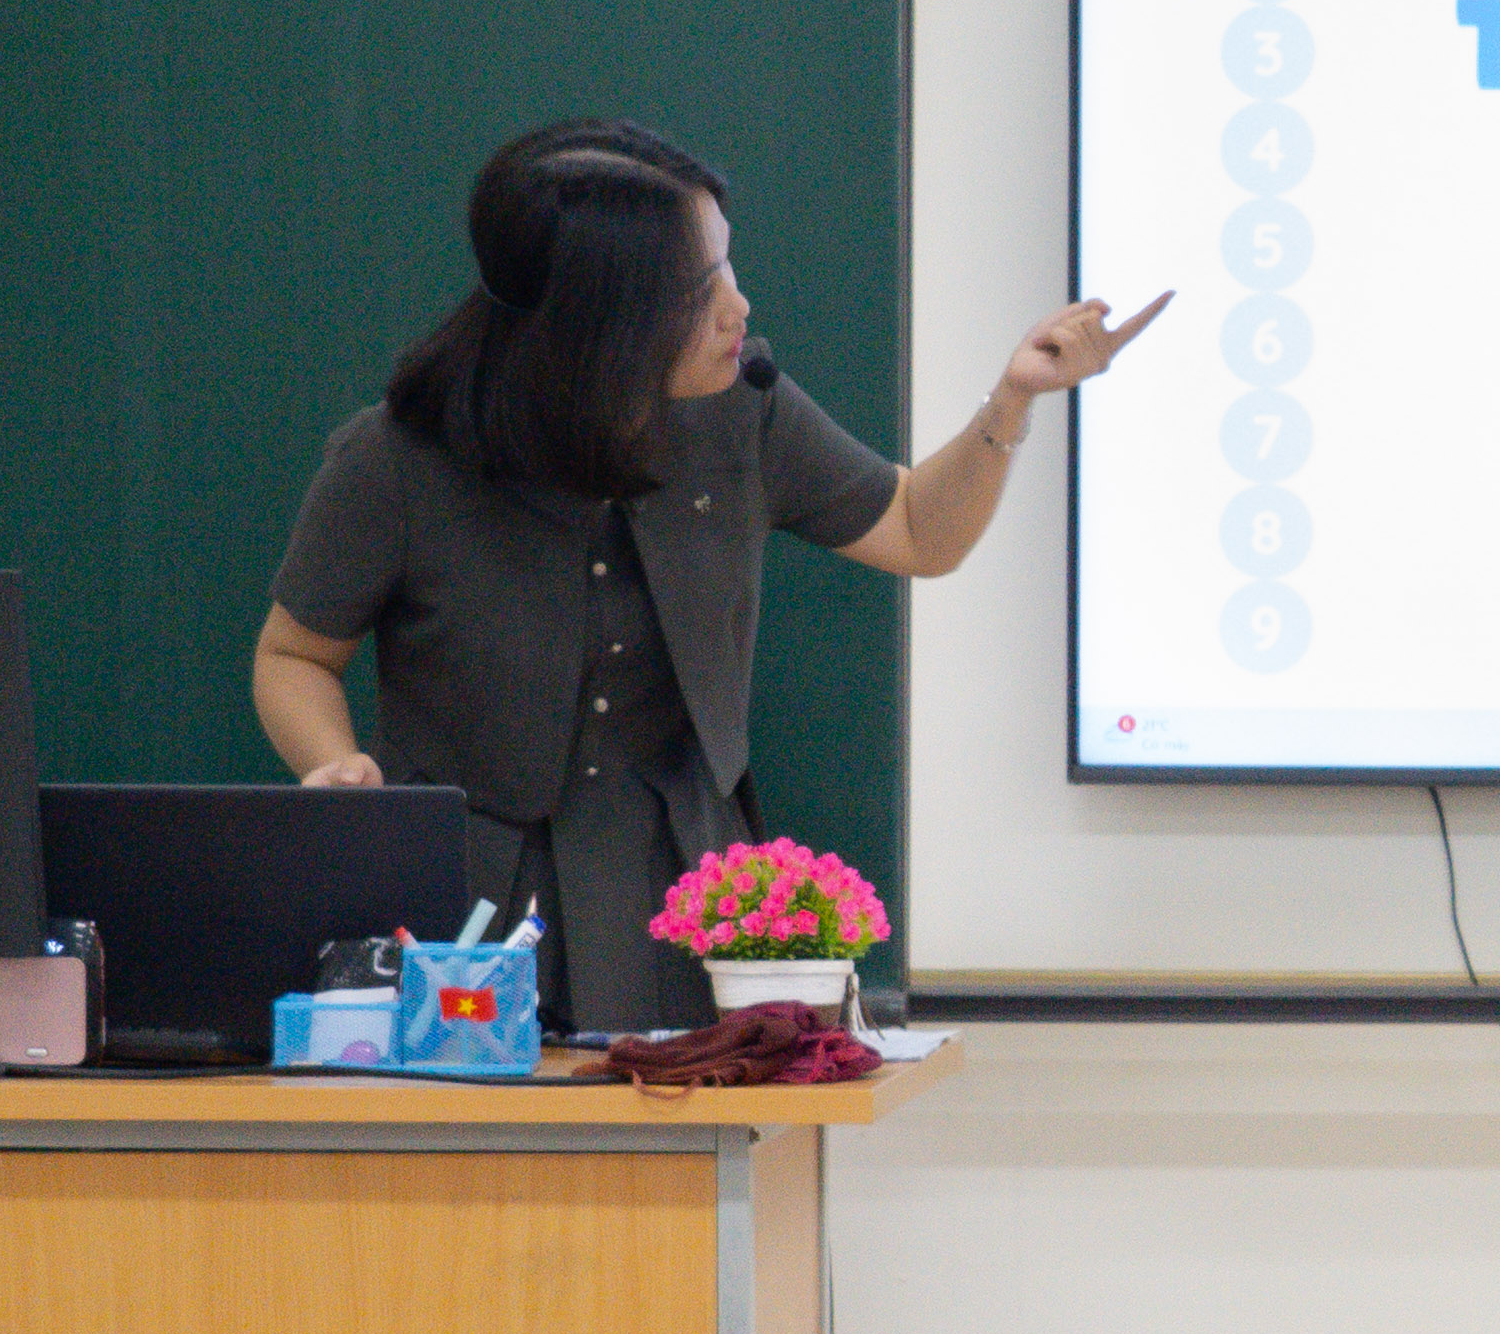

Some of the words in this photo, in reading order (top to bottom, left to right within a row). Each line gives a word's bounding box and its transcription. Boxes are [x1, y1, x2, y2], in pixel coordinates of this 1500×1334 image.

[1254, 31, 1283, 77] 3
[1251, 124, 1285, 172] 4
[1252, 222, 1283, 269] 5
[1251, 320, 1284, 365] 6
[1252, 415, 1284, 461] 7
[1251, 510, 1284, 555] 8
[1251, 606, 1283, 651] 9
